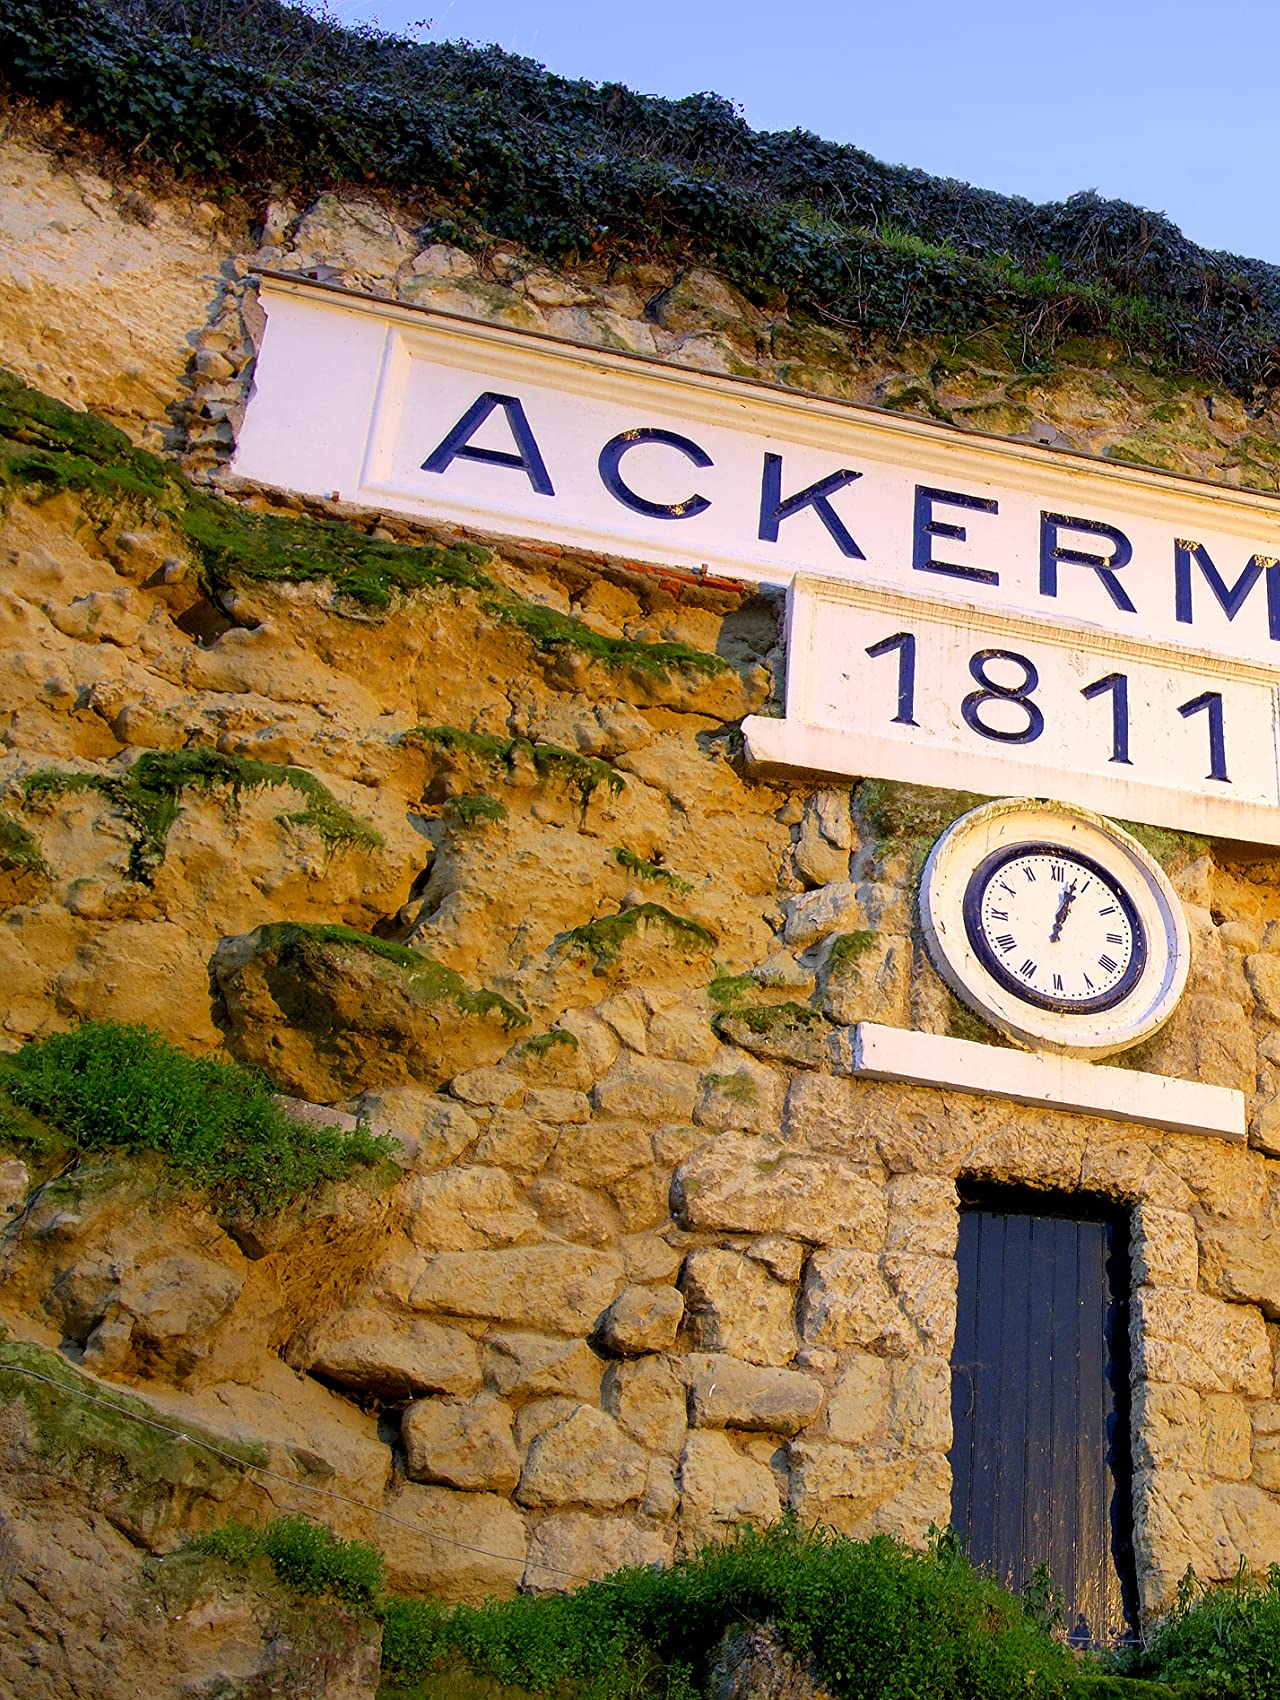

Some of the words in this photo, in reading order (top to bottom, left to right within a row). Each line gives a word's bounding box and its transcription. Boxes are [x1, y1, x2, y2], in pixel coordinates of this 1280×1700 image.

[865, 632, 1232, 784] 1811
[1023, 867, 1036, 882] XI
[1051, 865, 1064, 882] XII
[1000, 882, 1016, 897] X
[991, 908, 1008, 920] IX
[1098, 907, 1116, 916] II
[996, 934, 1017, 953] VIII
[1106, 933, 1122, 944] III
[1020, 959, 1038, 978] VII
[1053, 974, 1063, 991] VI
